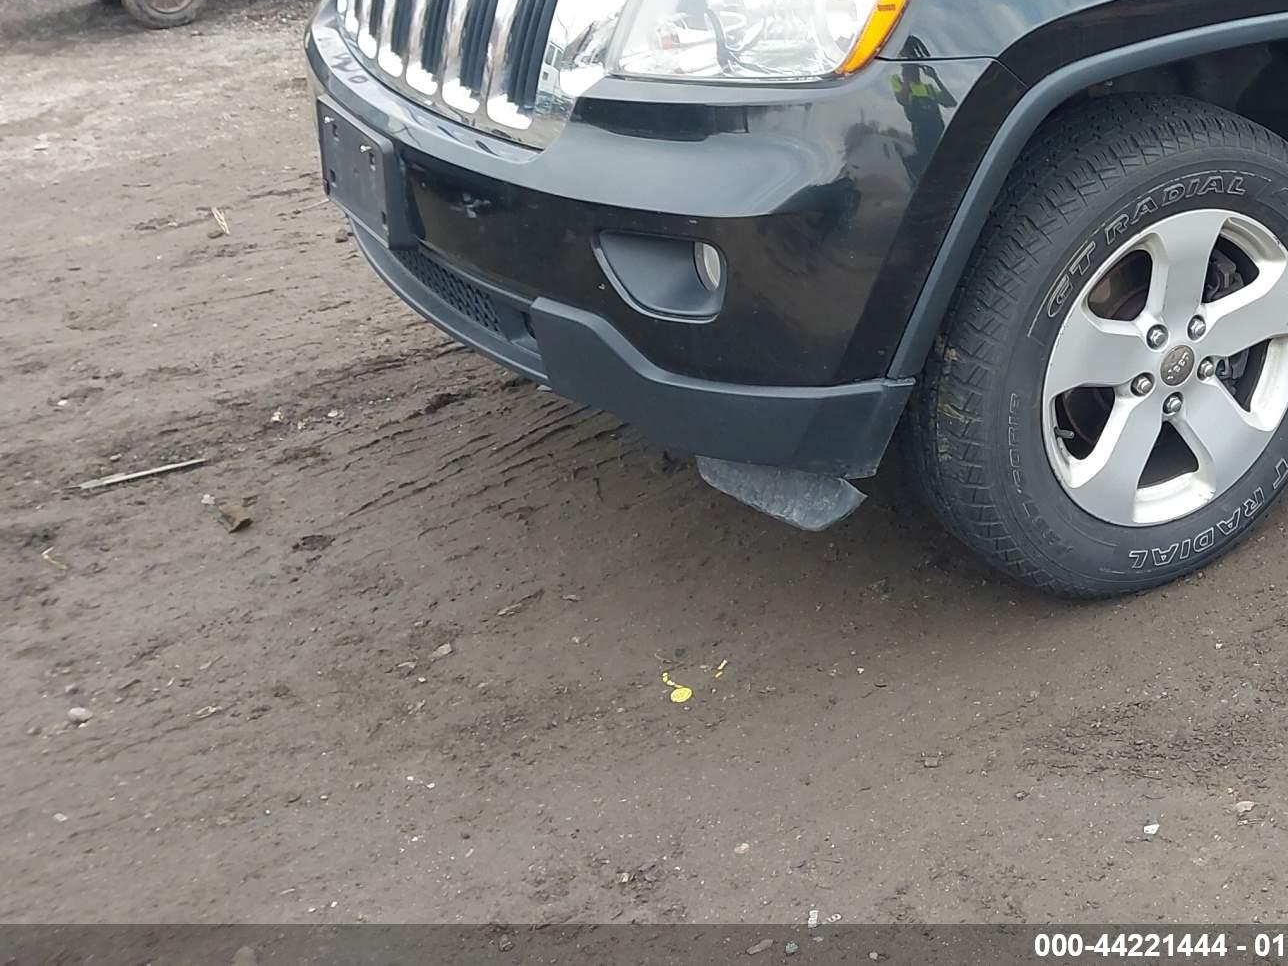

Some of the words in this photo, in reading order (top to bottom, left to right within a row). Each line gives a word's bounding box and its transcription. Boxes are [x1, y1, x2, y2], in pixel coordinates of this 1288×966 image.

[1047, 241, 1096, 318] GT
[1105, 175, 1247, 246] RADIAL
[1128, 486, 1267, 570] RADIAL
